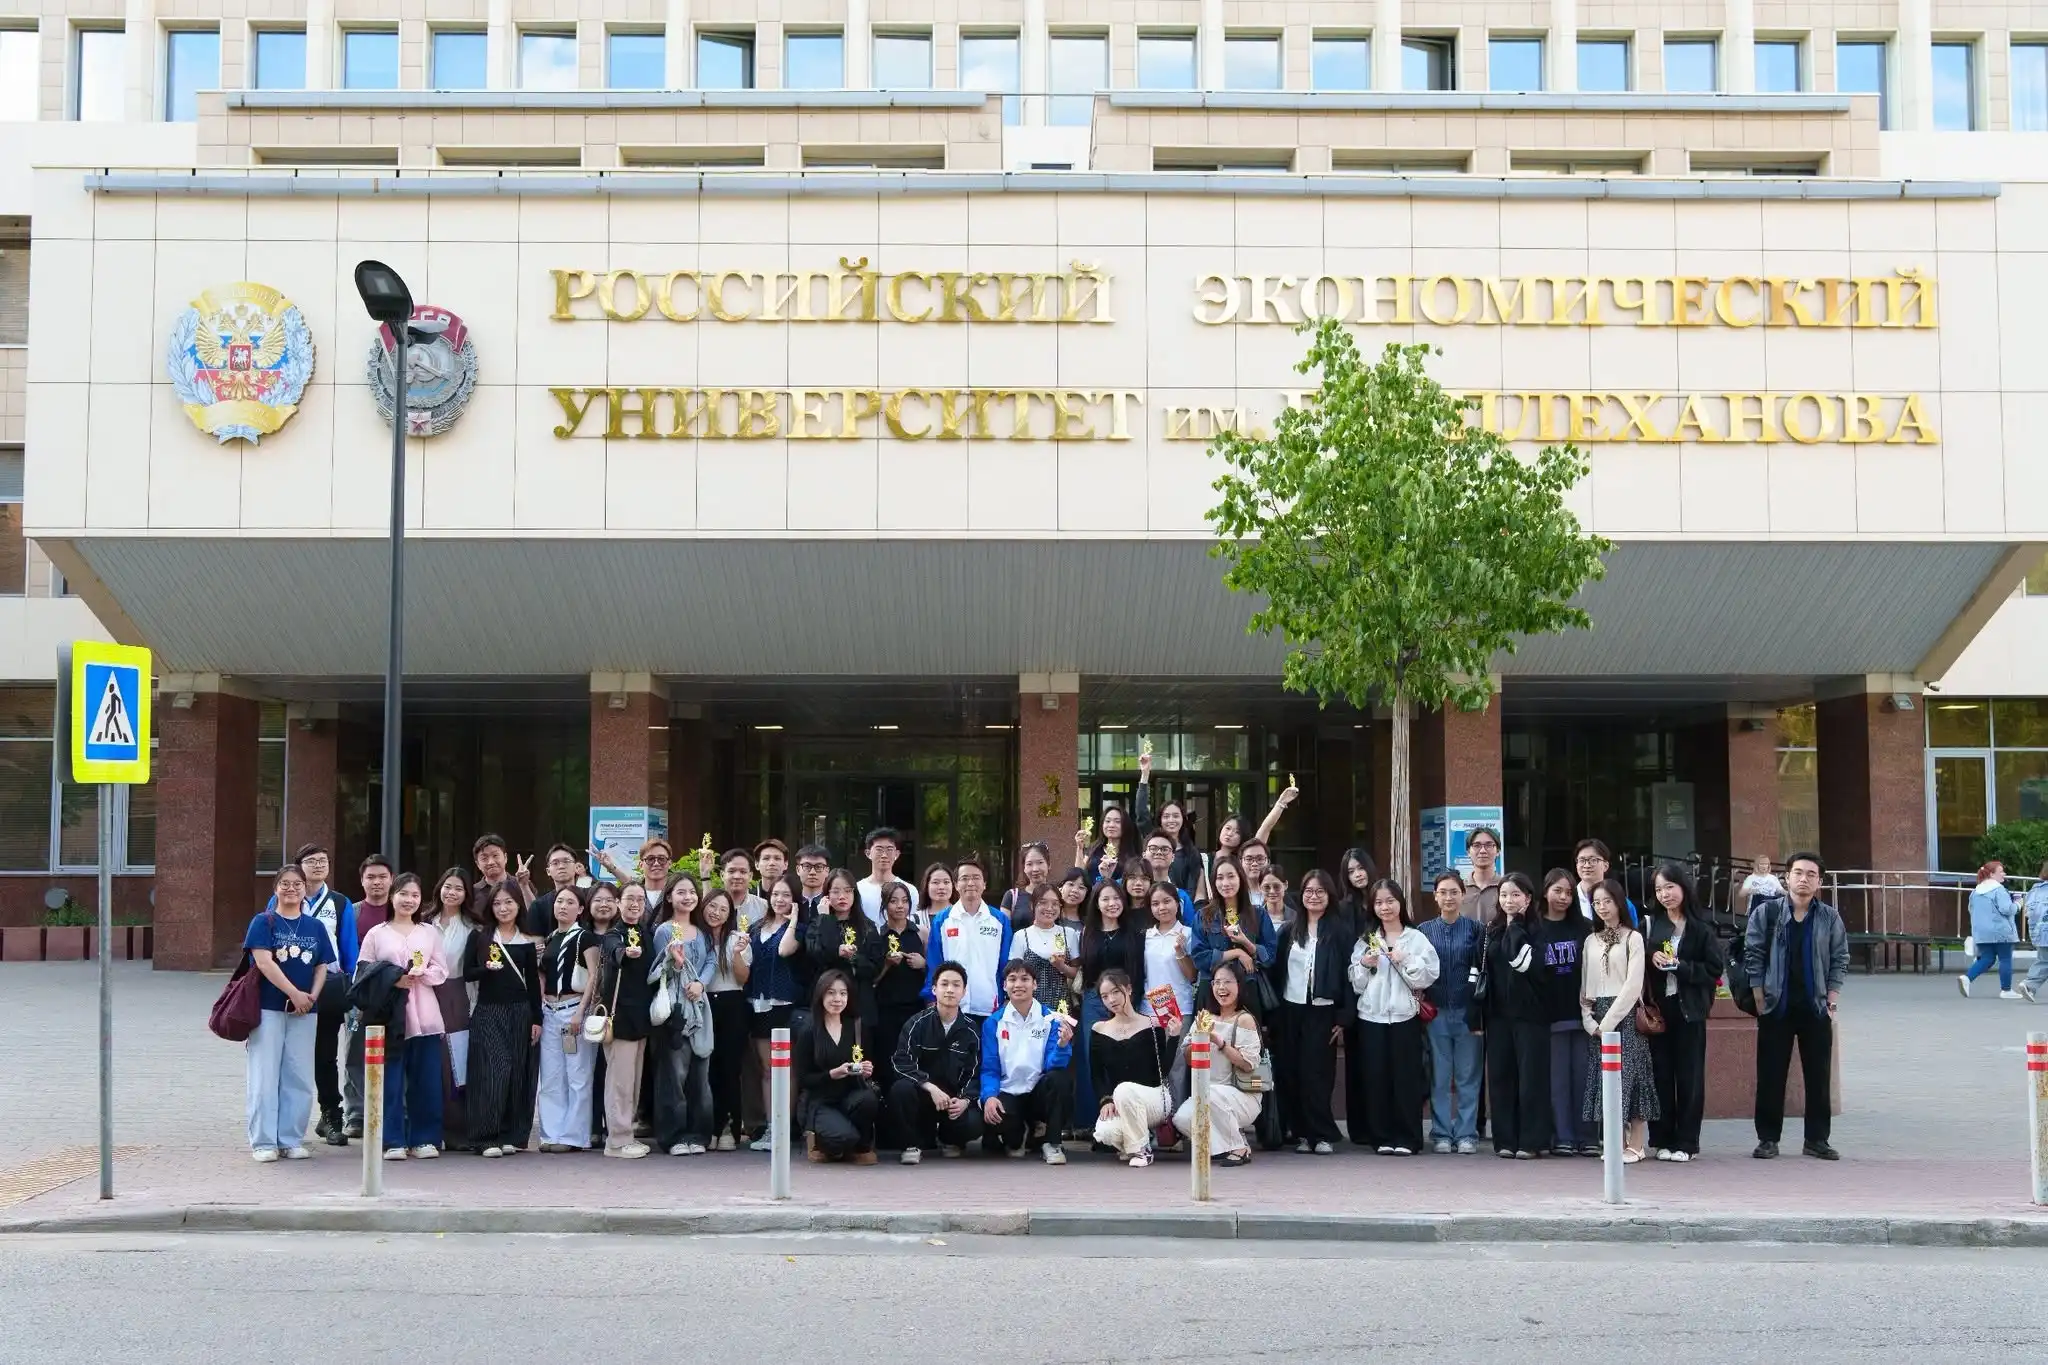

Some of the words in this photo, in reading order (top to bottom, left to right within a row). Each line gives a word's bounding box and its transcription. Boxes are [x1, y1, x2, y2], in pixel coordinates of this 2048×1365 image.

[548, 256, 1116, 323] РОССИЙСКИЙ
[1192, 265, 1938, 329] ЭКОНОМИЧЕСКИЙ
[548, 387, 1144, 440] УНИВЕРСИТЕТ
